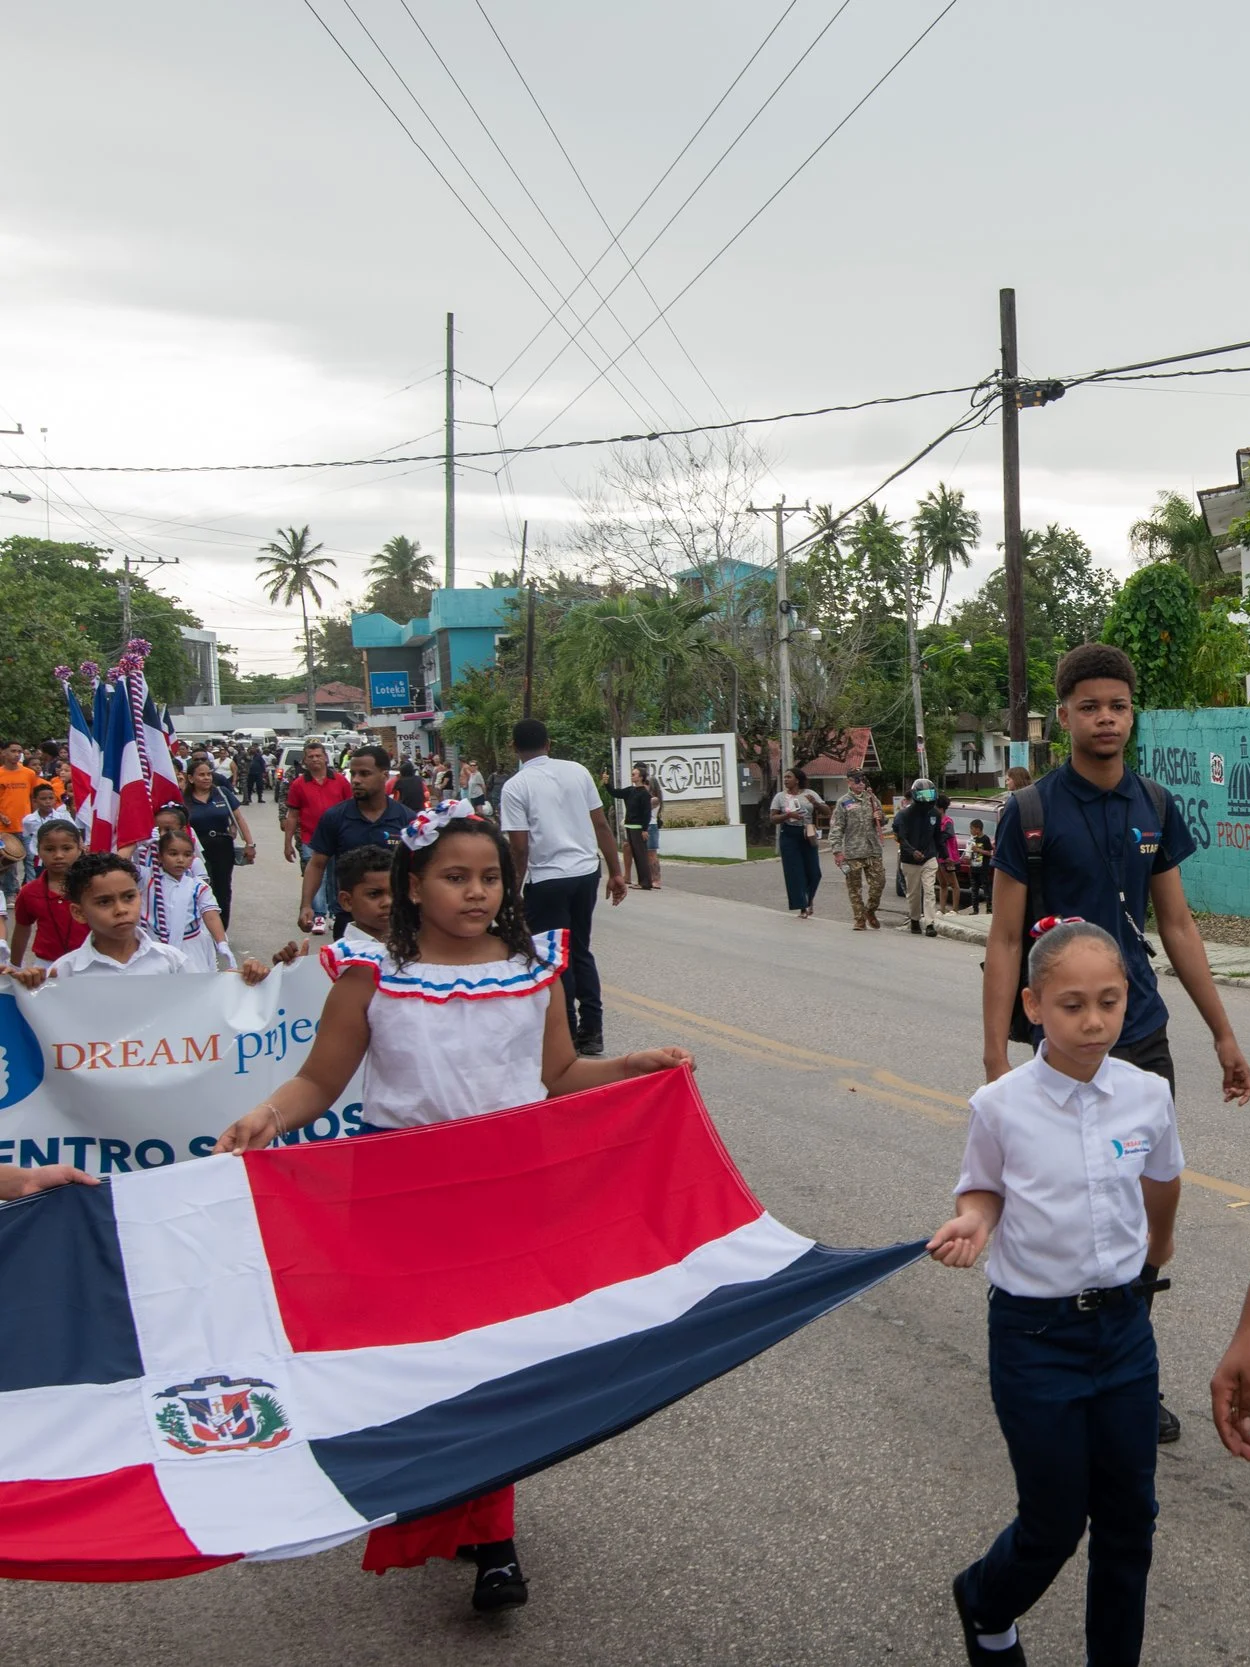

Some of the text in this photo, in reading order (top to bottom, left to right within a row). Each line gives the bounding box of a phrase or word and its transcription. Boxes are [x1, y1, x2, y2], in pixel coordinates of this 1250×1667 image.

[375, 684, 406, 695] Loteka
[1137, 744, 1150, 778] EL
[1152, 746, 1190, 786] PASEO
[1189, 768, 1201, 786] LOS
[52, 1008, 320, 1074] DREAM prje
